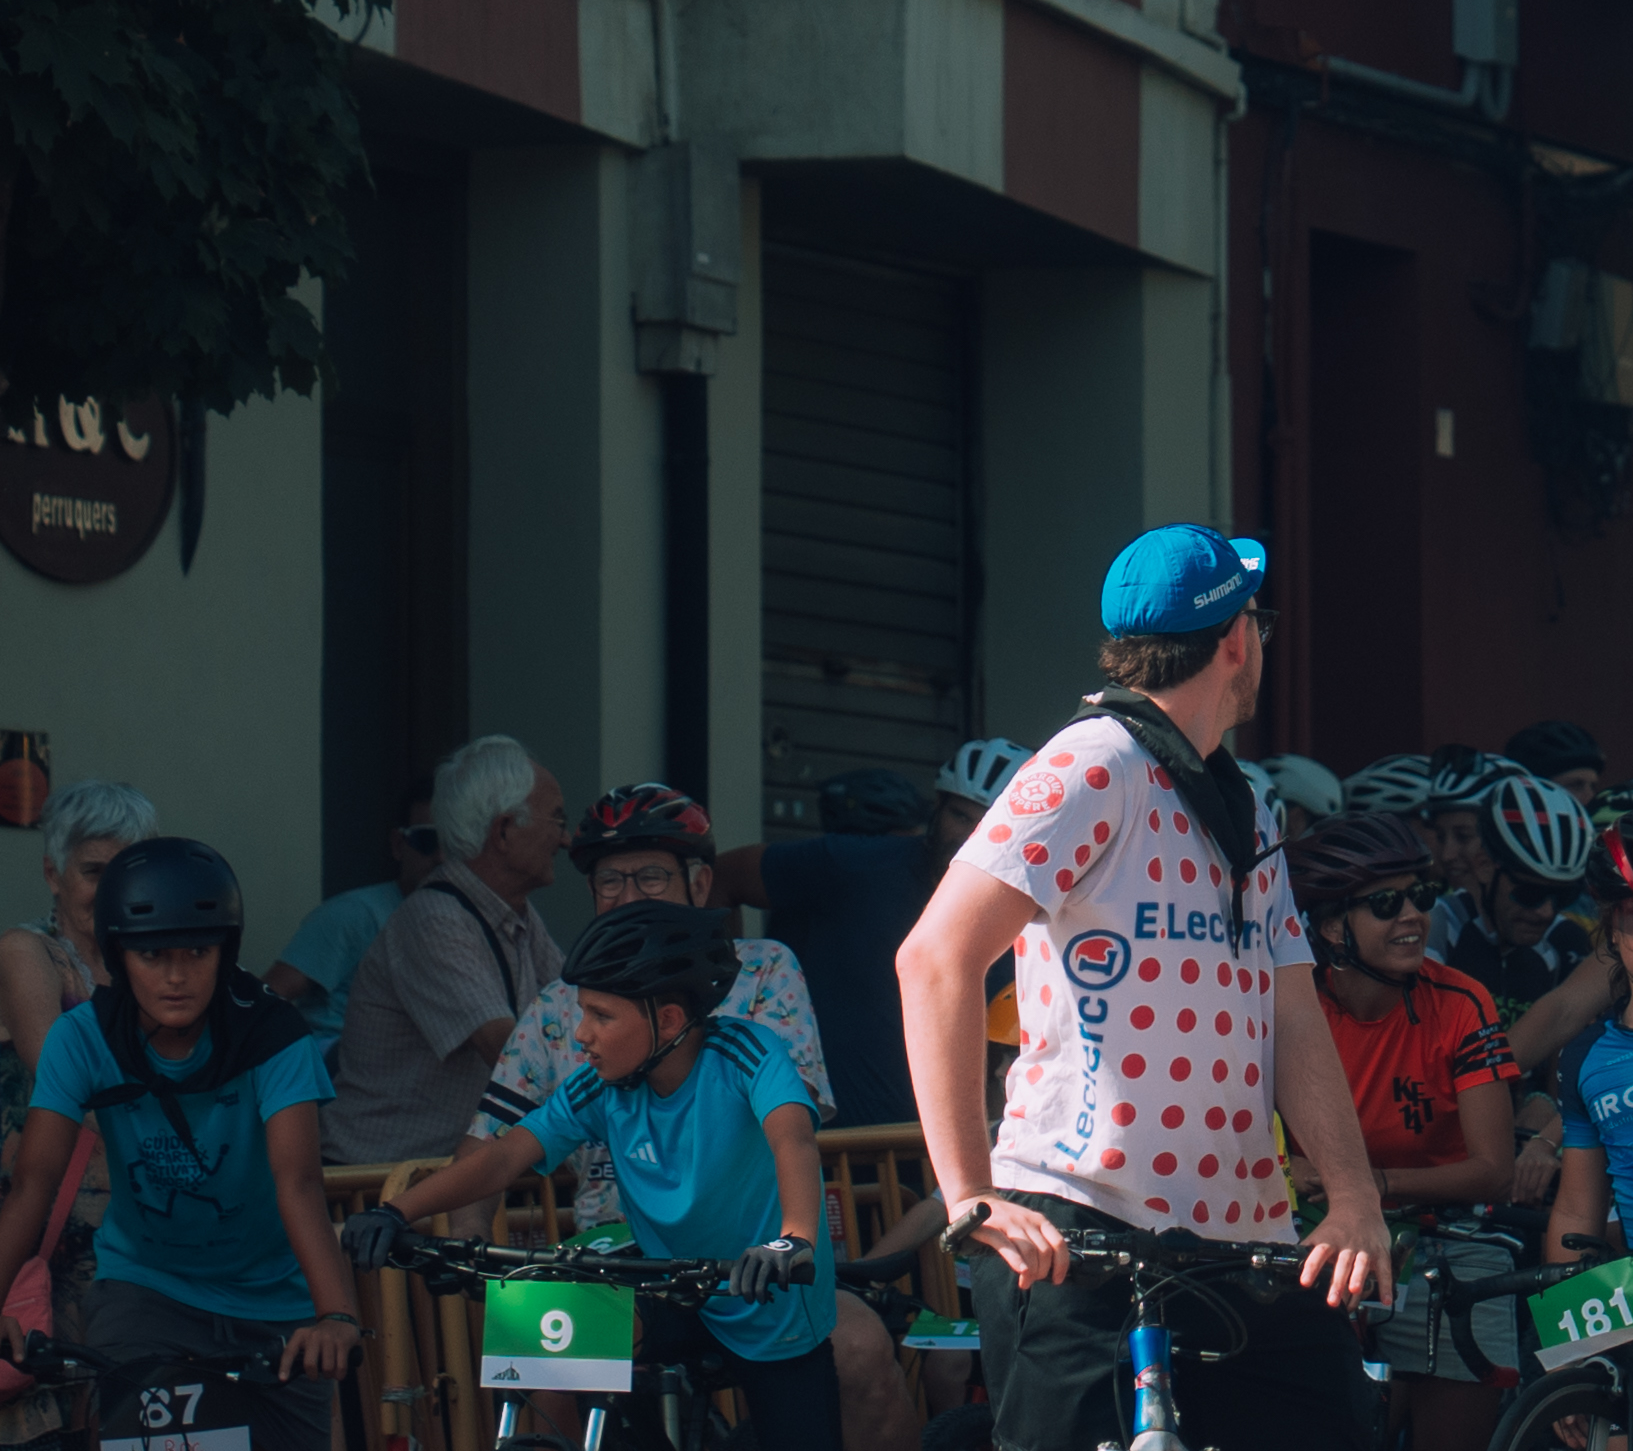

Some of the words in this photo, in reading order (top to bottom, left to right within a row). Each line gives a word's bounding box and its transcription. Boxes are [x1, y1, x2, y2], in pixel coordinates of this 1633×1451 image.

[32, 491, 118, 540] perruquers
[1193, 572, 1244, 610] SHIMANO
[540, 1310, 574, 1352] 9
[139, 1383, 205, 1429] 87
